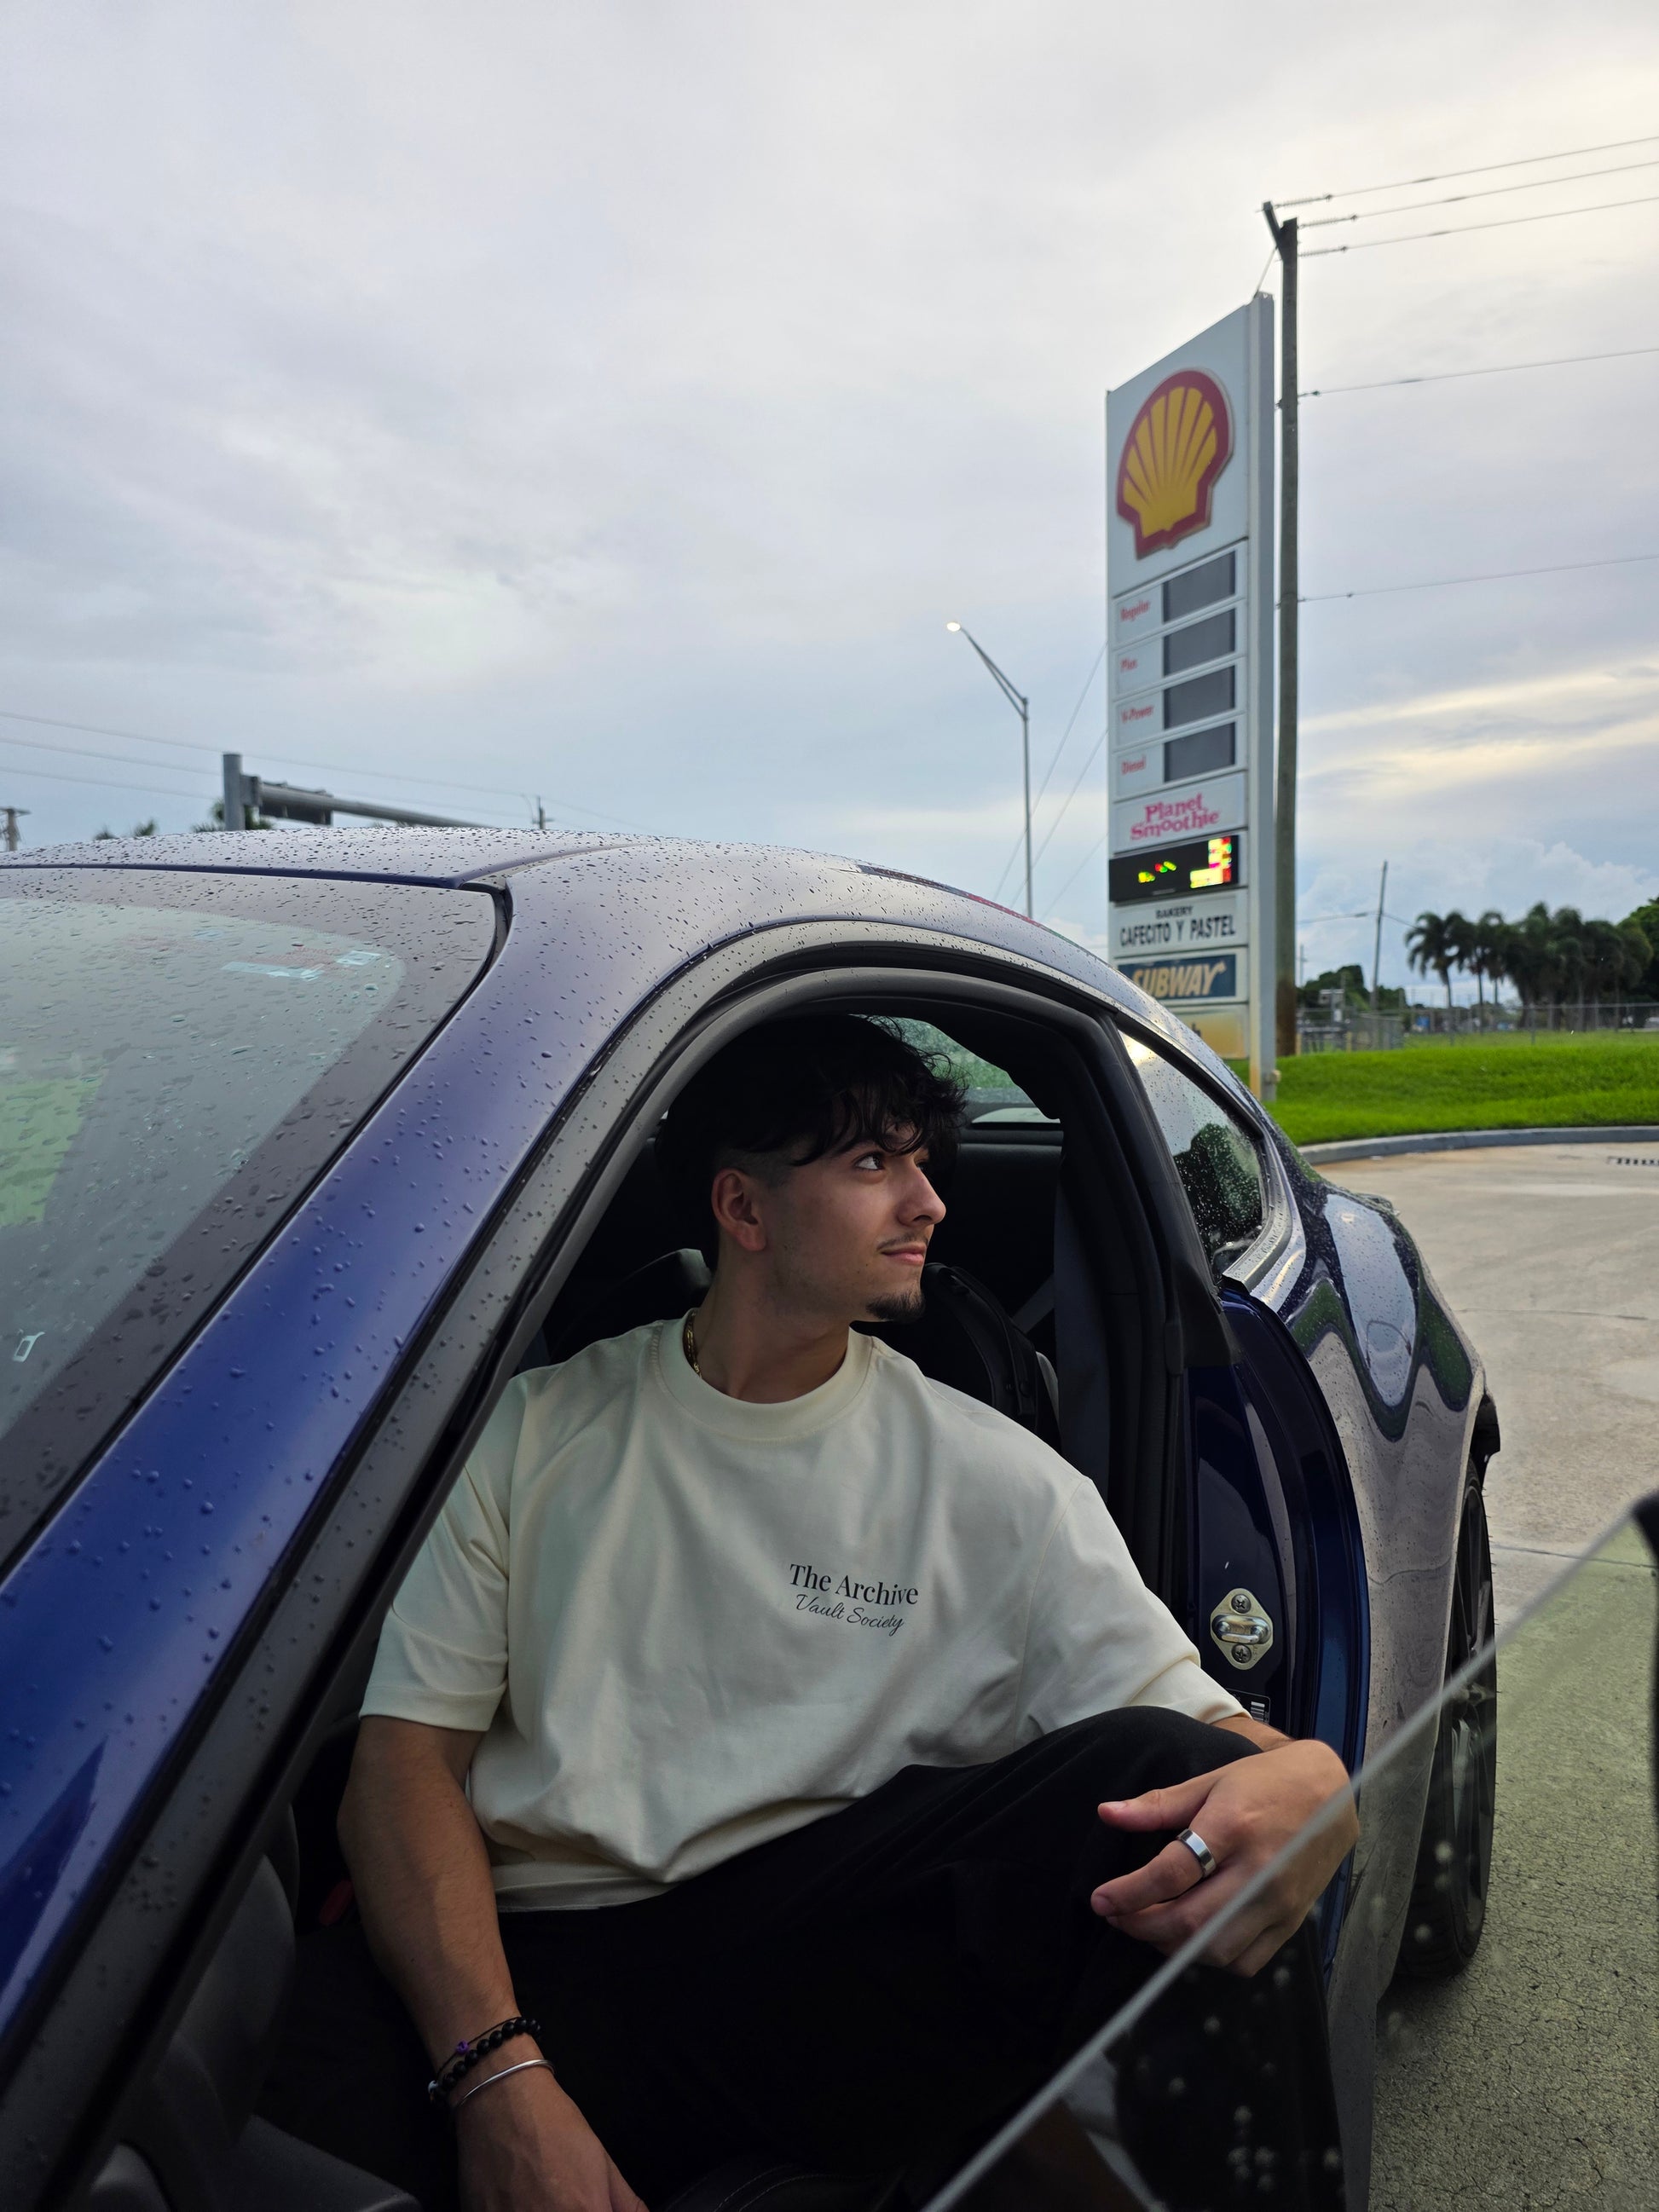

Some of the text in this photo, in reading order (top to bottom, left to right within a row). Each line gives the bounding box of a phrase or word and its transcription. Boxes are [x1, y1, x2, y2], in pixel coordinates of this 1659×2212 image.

[1130, 808, 1220, 840] Smoothie
[1145, 793, 1202, 823] Planet
[1156, 905, 1193, 919] BAKERY
[1120, 914, 1235, 947] CAFECITO Y PASTEL
[789, 1563, 919, 1606] The Archive
[796, 1593, 905, 1637] Vault Society
